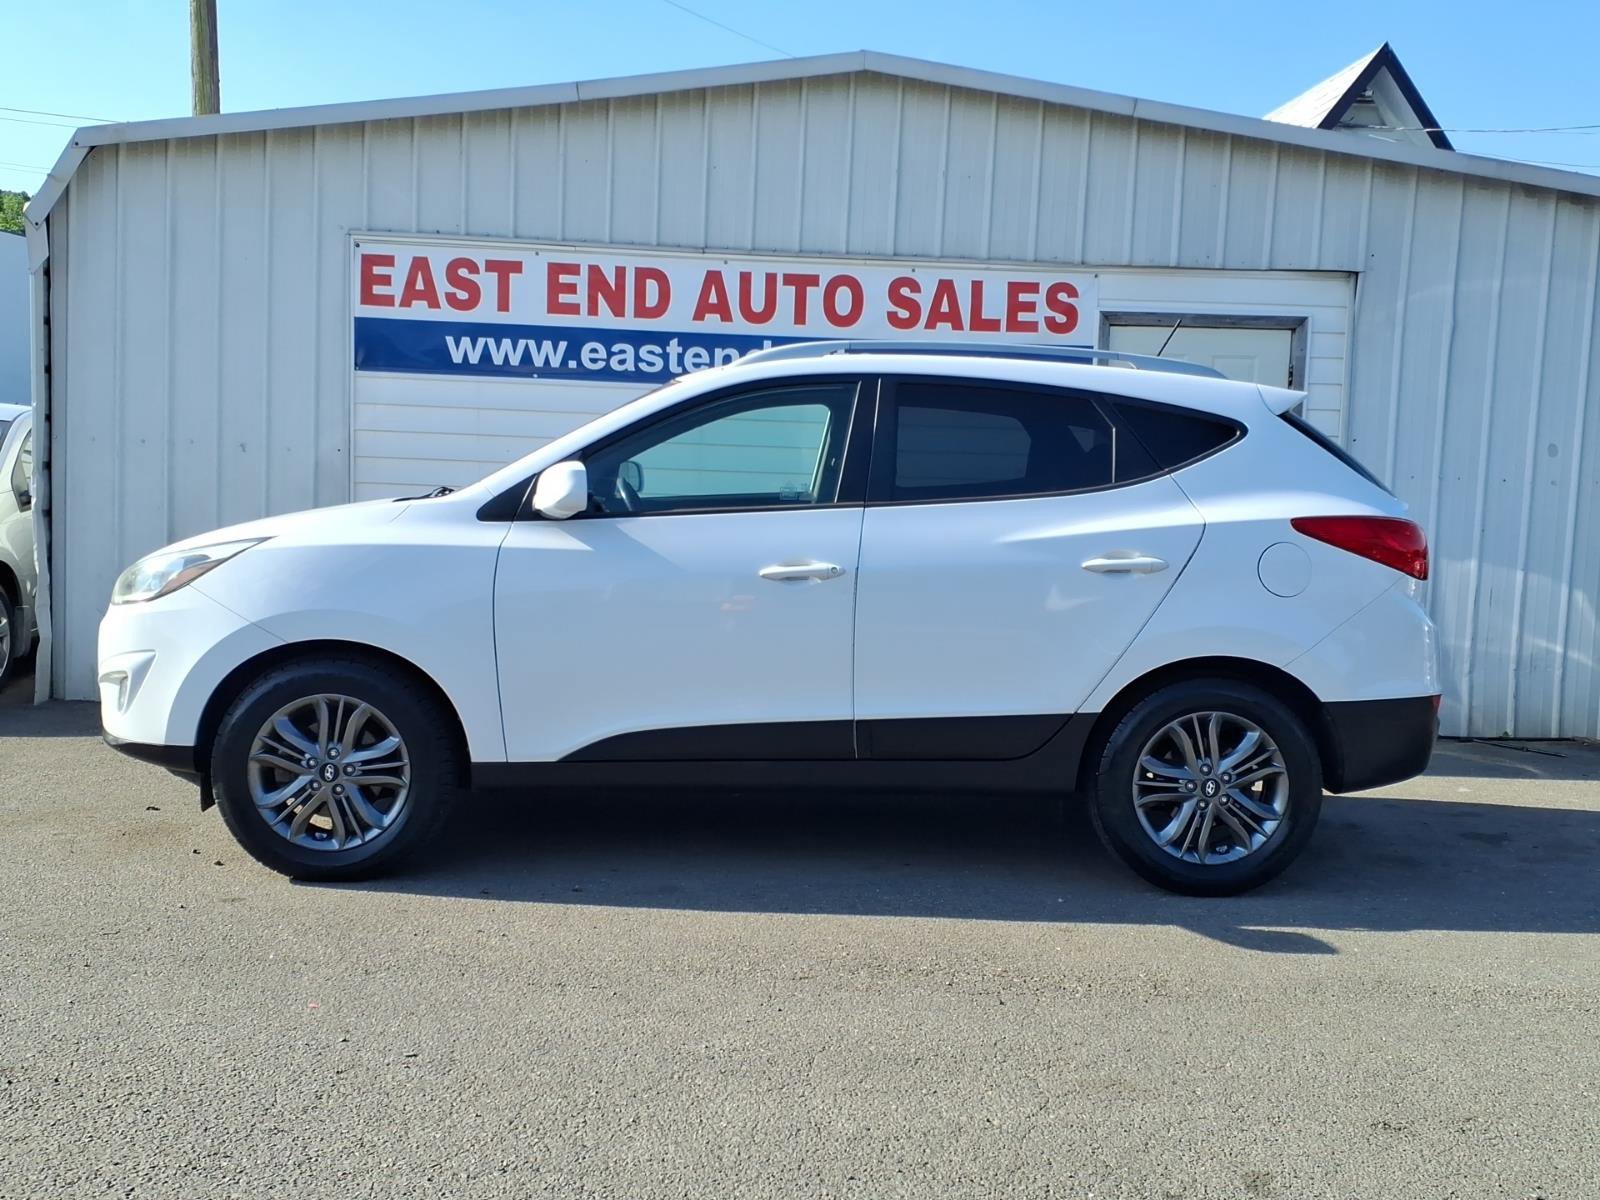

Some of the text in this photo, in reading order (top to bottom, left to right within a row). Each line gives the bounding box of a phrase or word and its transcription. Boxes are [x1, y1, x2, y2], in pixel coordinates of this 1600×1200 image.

[360, 254, 1079, 335] EAST END AUTO SALES
[445, 335, 772, 374] www.easten
